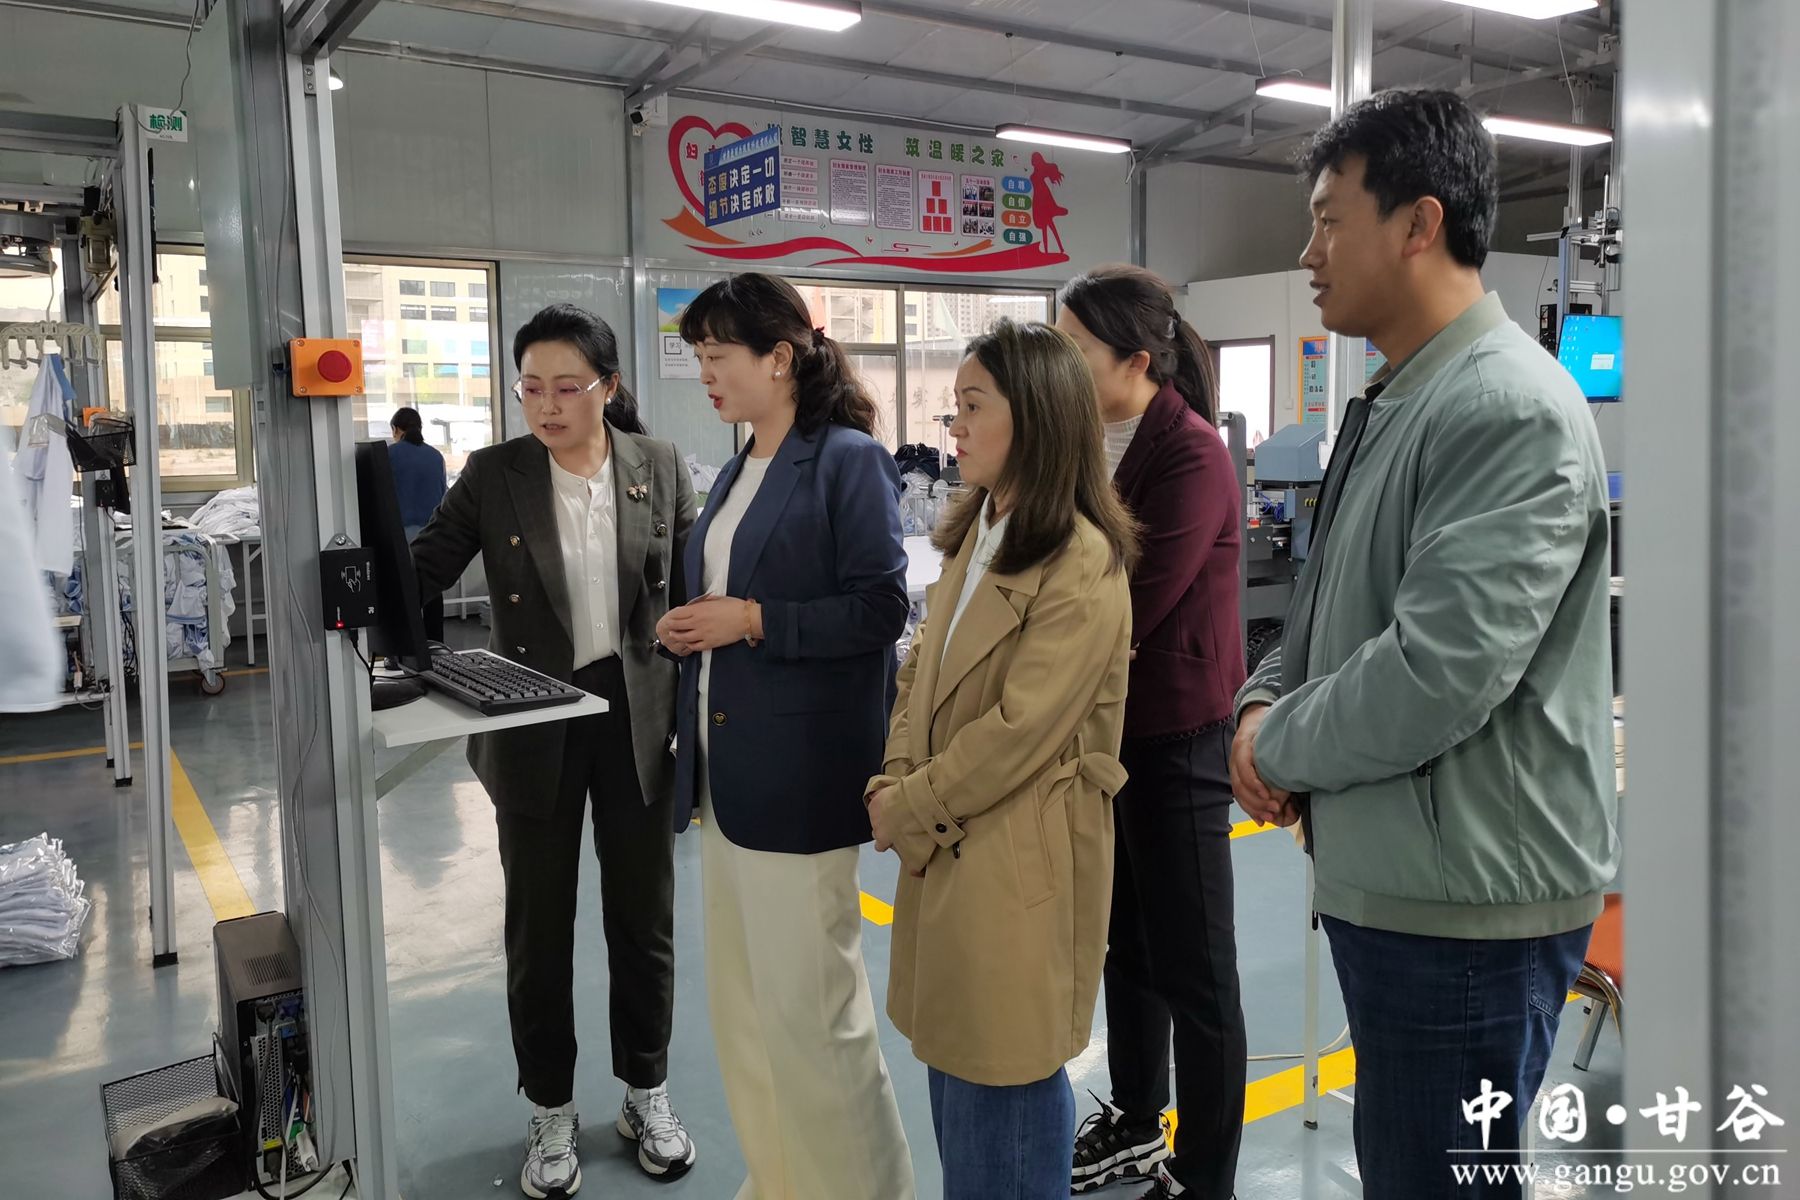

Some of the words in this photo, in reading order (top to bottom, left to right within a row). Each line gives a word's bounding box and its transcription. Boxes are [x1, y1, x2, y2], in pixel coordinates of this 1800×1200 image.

[149, 113, 183, 131] 检测
[905, 137, 1005, 167] 筑温暖之家
[708, 156, 775, 195] 态度决定一切
[708, 183, 775, 220] 细节决定成败
[1008, 197, 1026, 208] 自信
[1009, 214, 1026, 225] 自立
[1009, 231, 1027, 242] 自强
